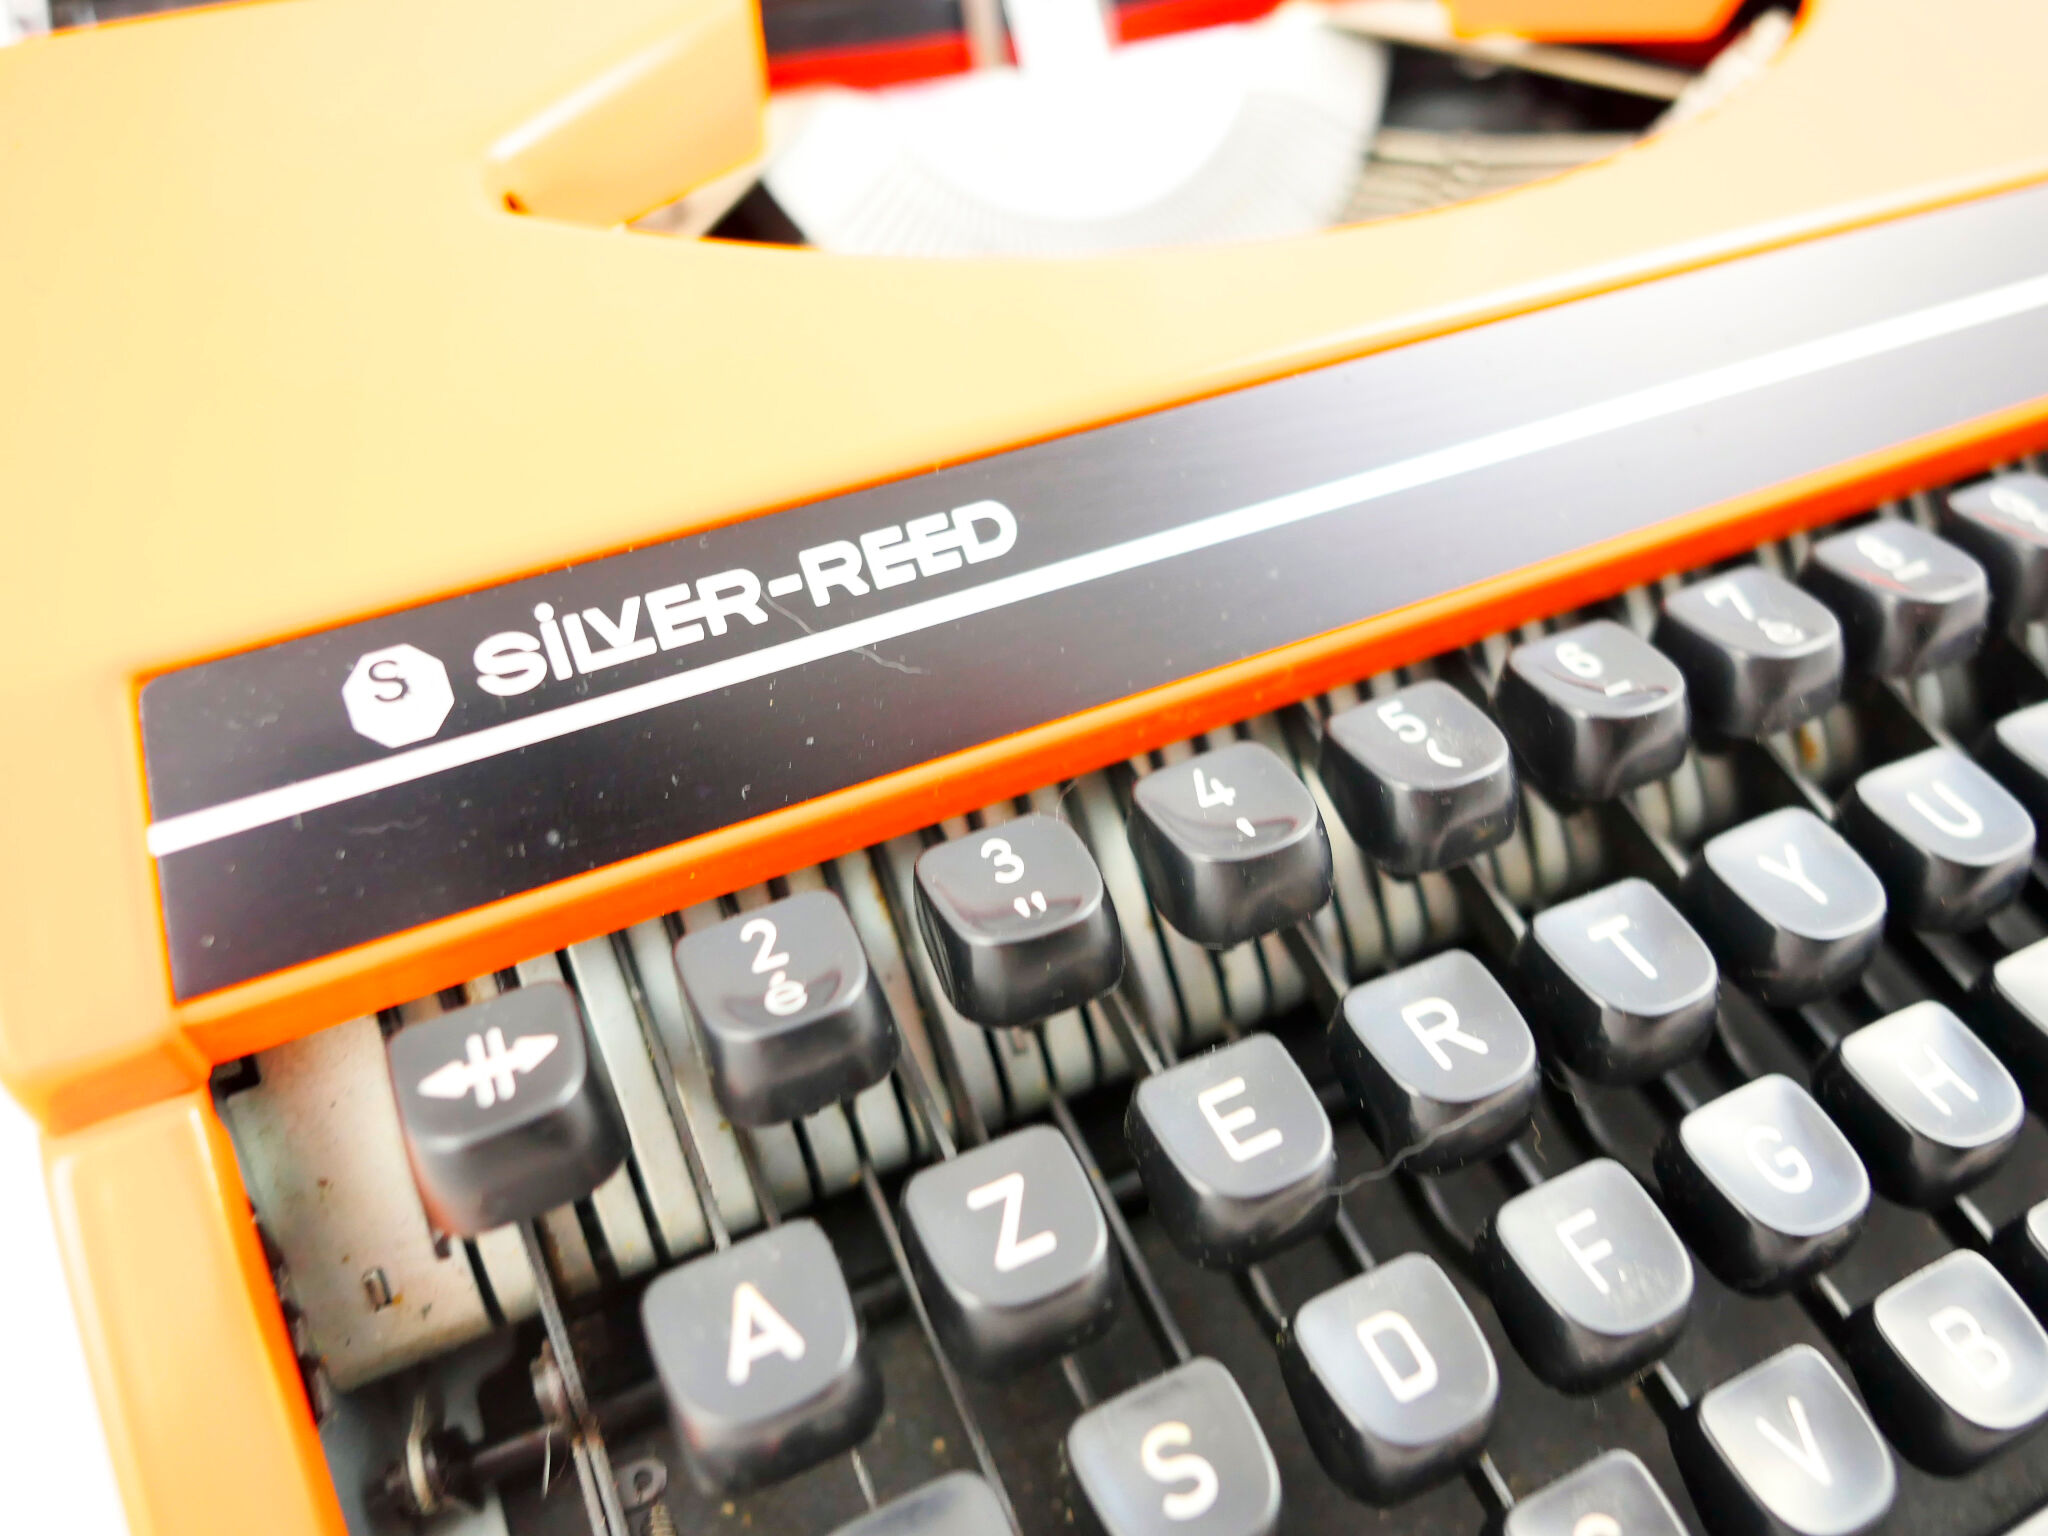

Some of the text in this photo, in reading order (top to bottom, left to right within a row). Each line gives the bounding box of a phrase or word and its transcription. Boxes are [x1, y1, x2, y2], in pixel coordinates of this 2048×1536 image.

[1703, 581, 1755, 622] 7
[368, 660, 409, 703] S
[1555, 641, 1602, 679] 6
[1376, 700, 1427, 743] 5
[1193, 768, 1235, 808] 4
[1906, 780, 1984, 840] U
[980, 838, 1024, 884] 3
[1757, 843, 1829, 906] Y
[740, 918, 789, 974] 2
[1587, 915, 1658, 980] T
[1400, 997, 1488, 1071] R
[1900, 1043, 1980, 1117] H
[1198, 1077, 1283, 1162] E
[1745, 1125, 1814, 1195] G
[967, 1173, 1057, 1272] Z
[1556, 1207, 1613, 1296] F
[727, 1282, 804, 1384] A
[1357, 1310, 1438, 1402] D
[1930, 1306, 2012, 1390] B
[1140, 1421, 1218, 1520] S
[1756, 1395, 1832, 1487] V
